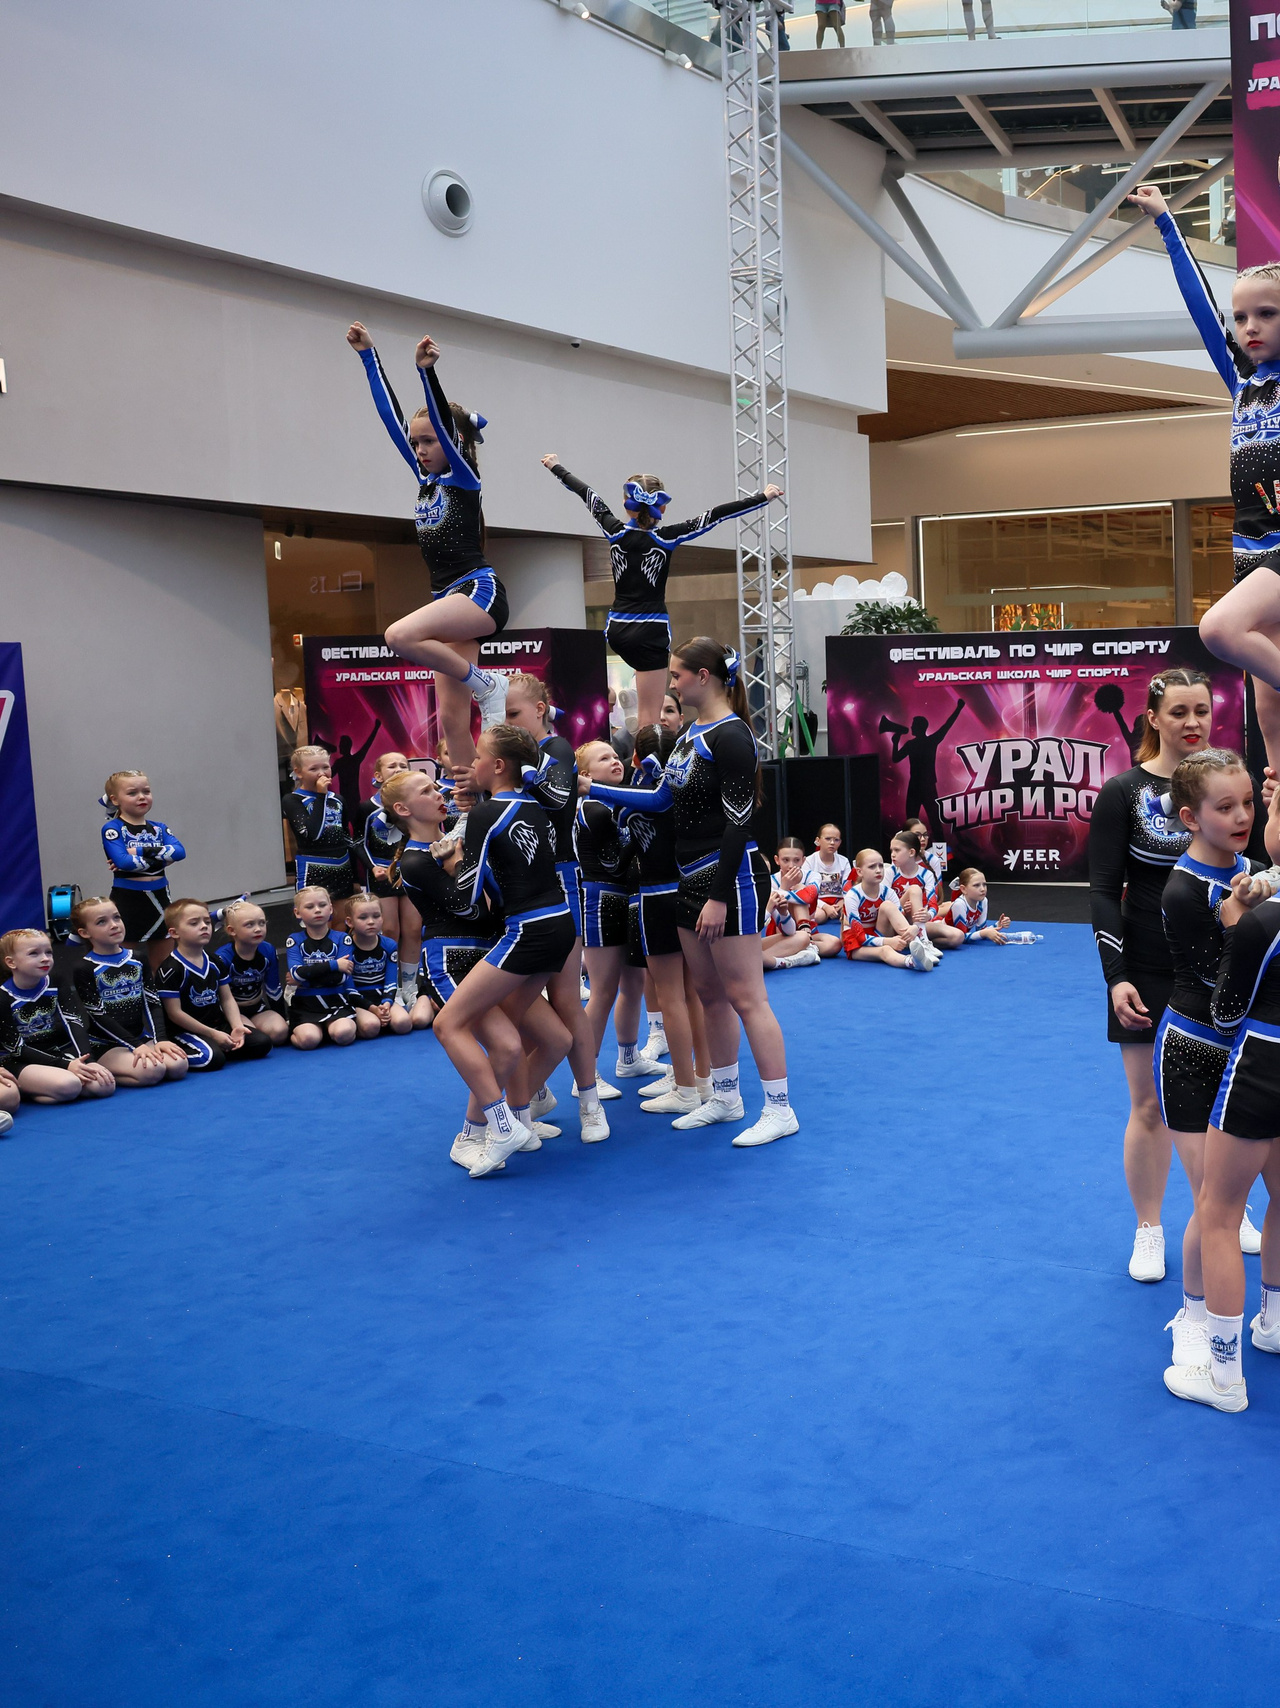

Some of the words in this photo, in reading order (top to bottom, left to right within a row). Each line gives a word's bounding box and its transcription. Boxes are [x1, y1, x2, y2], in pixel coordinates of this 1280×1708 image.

[321, 645, 400, 661] ФЕСТИВА
[480, 640, 543, 655] СПОРТУ
[889, 645, 1001, 663] ФЕСТИВАЛЬ
[1009, 644, 1036, 658] ПО
[1044, 643, 1083, 657] ЧИР
[1092, 640, 1171, 655] СПОРТУ
[335, 671, 400, 682] УРАЛЬСКАЯ
[404, 670, 435, 680] ШКОЛ
[918, 671, 992, 682] УРАЛЬСКАЯ
[996, 669, 1041, 680] ШКОЛА
[1046, 669, 1072, 678] ЧИР
[1077, 667, 1129, 677] СПОРТА
[961, 740, 1104, 789] УРАЛ
[942, 788, 1015, 828] ЧИР
[1022, 787, 1046, 817] И
[1053, 787, 1100, 820] РО
